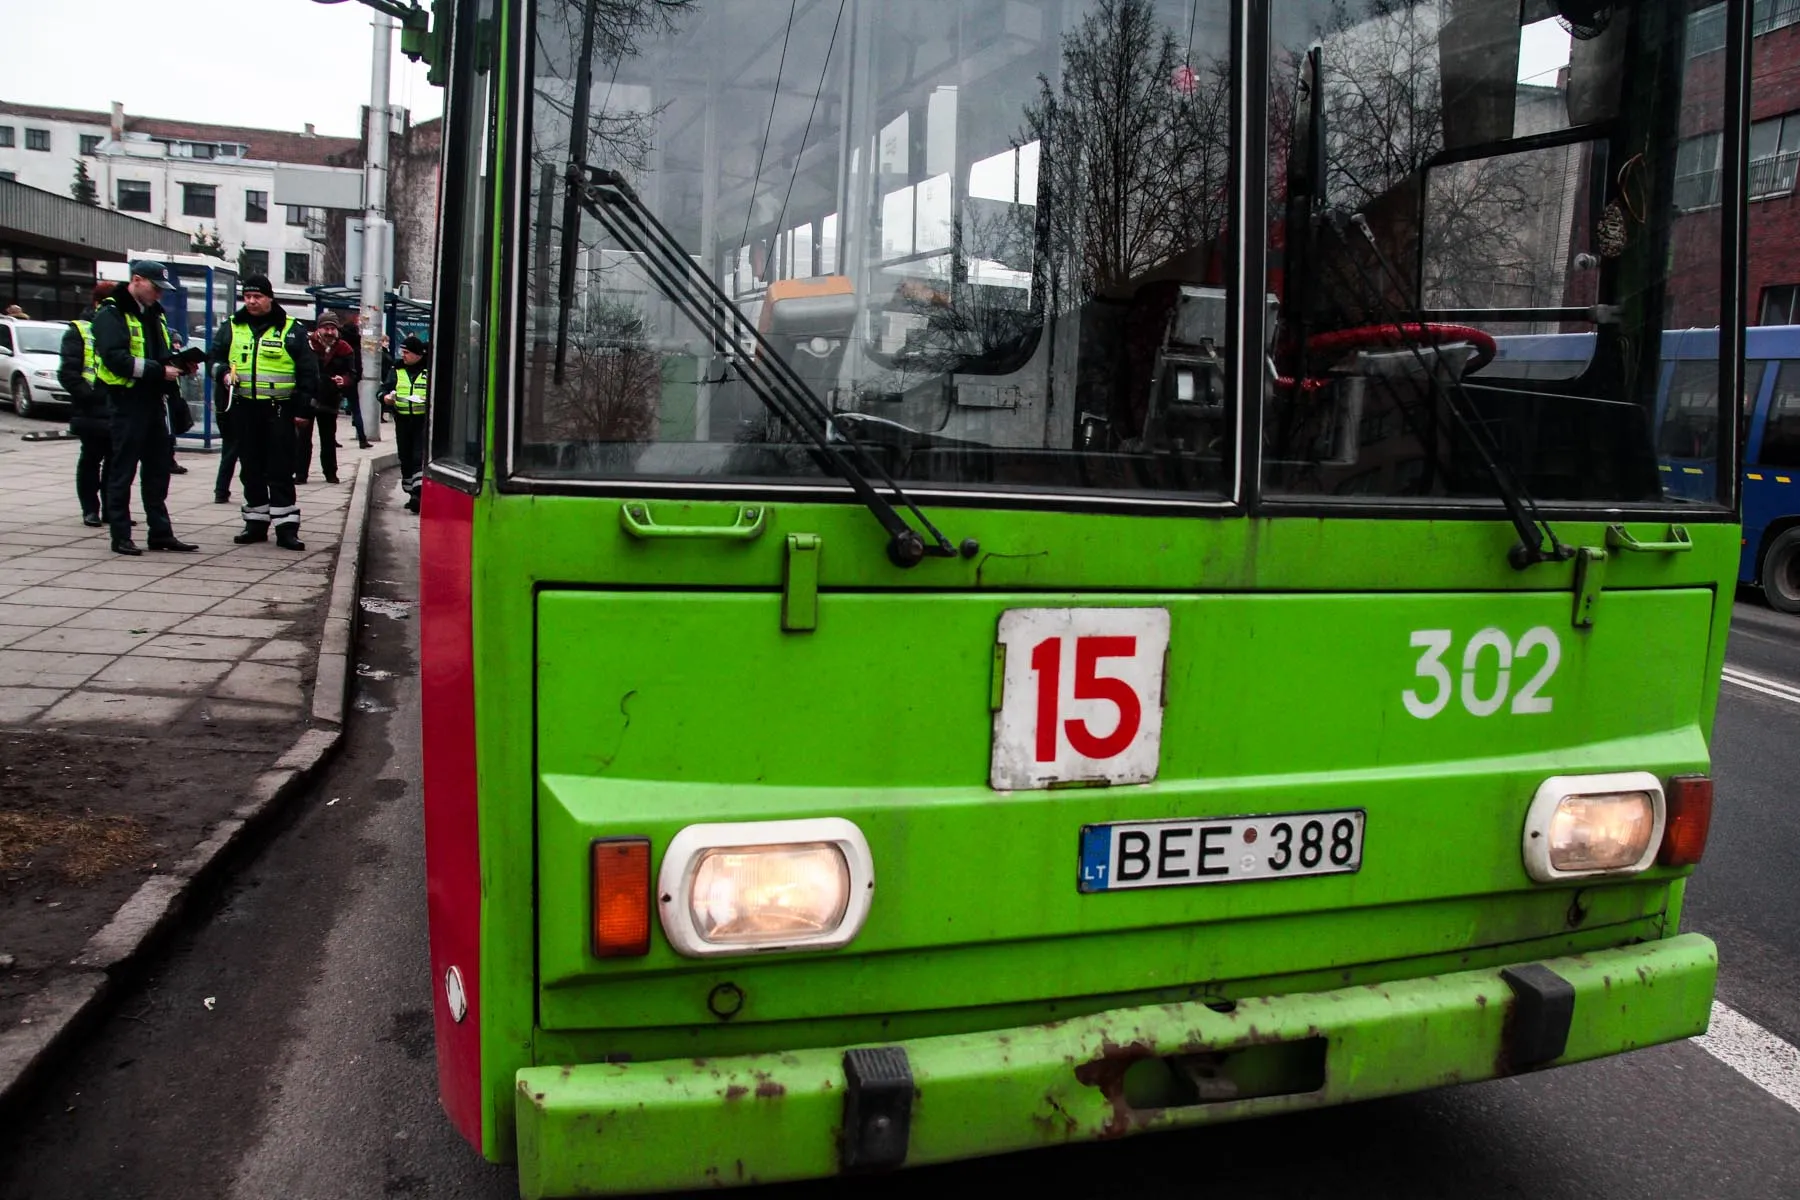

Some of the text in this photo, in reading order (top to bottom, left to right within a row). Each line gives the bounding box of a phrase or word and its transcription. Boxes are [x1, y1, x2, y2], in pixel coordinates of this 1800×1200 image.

[1031, 636, 1141, 762] 15
[1402, 626, 1561, 719] 302
[1085, 866, 1106, 880] LT
[1117, 818, 1354, 882] BEE 388
